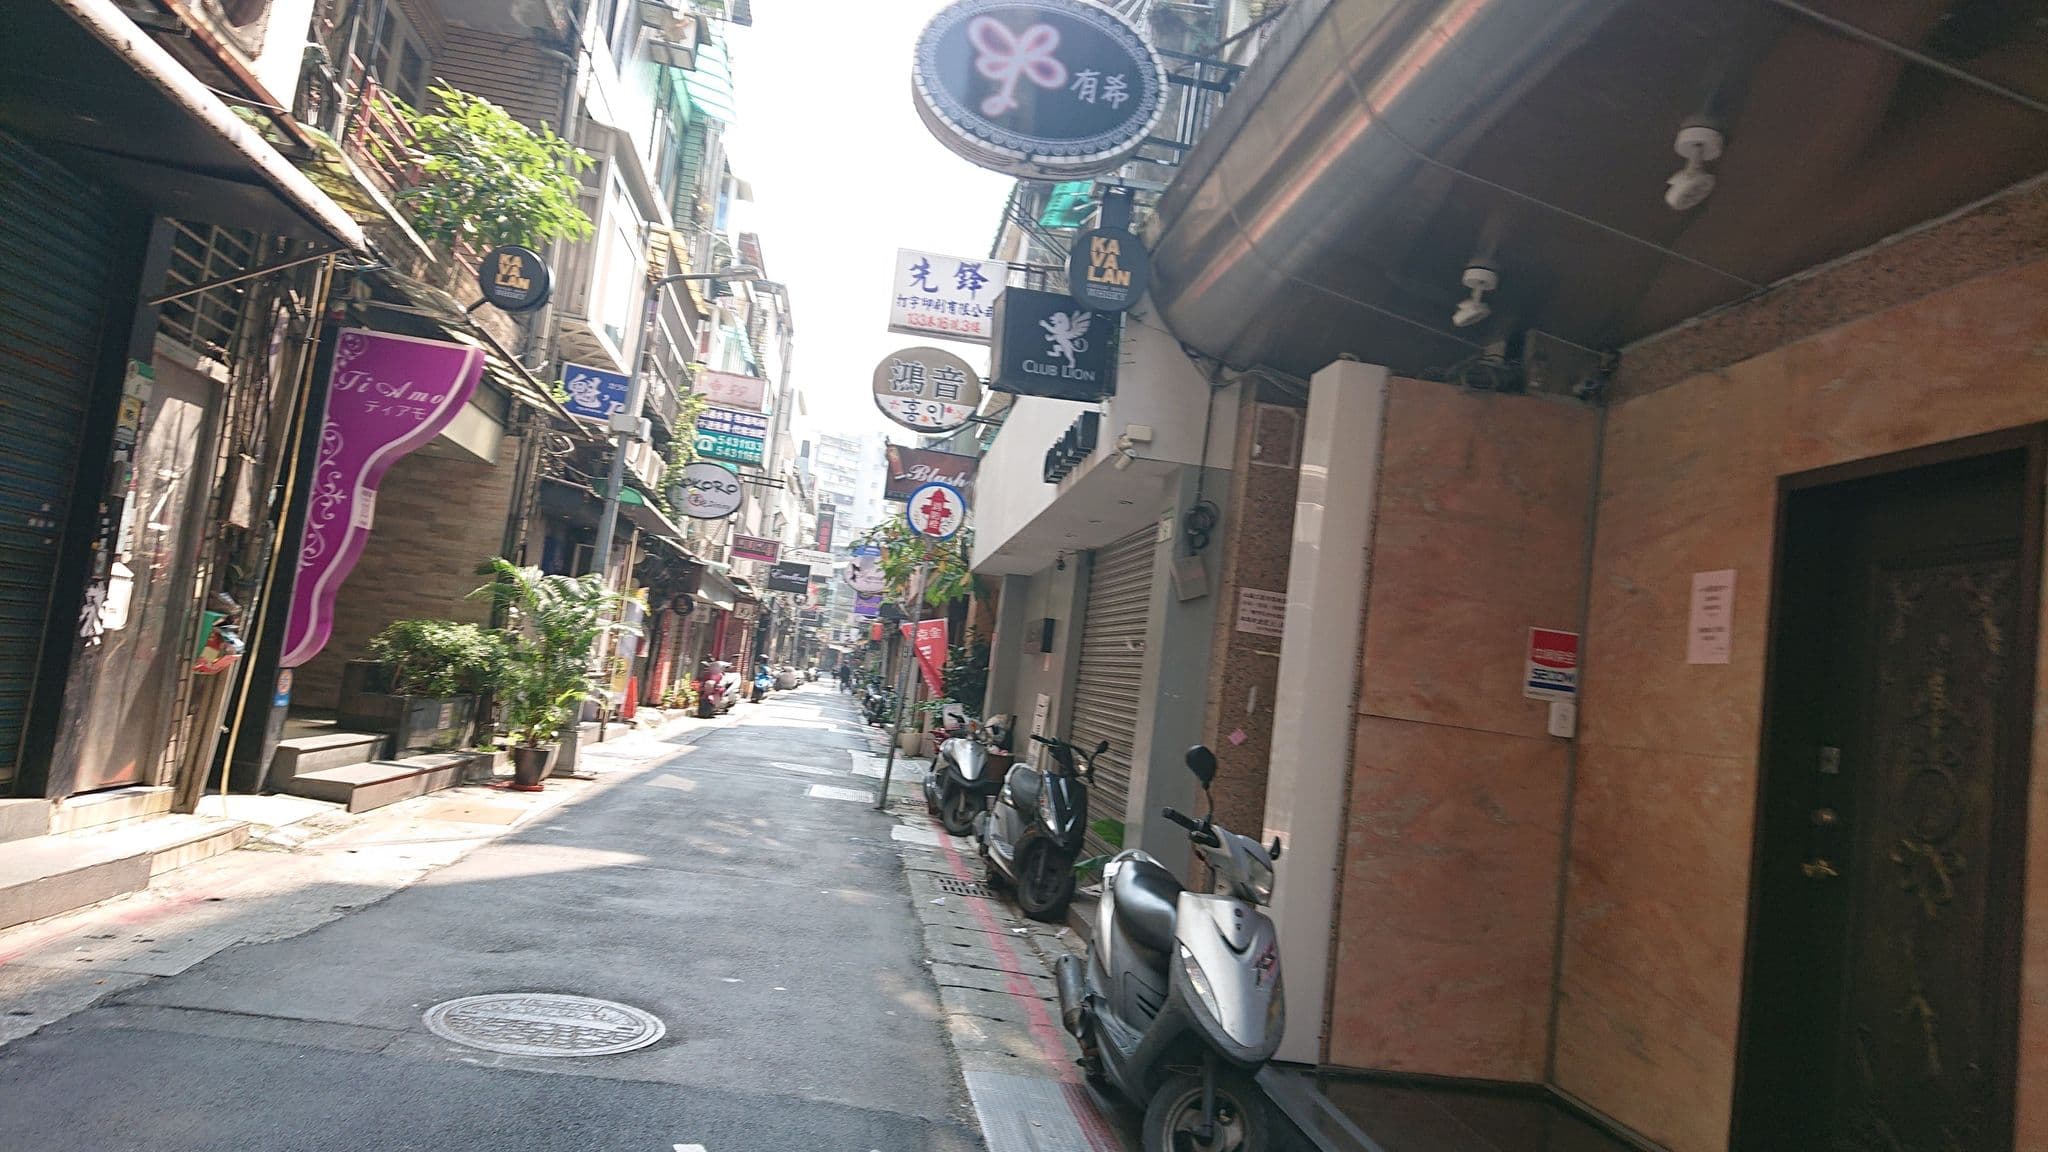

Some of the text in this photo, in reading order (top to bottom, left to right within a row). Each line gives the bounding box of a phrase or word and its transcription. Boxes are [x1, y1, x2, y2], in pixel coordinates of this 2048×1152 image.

[1070, 68, 1129, 109] 有希
[1091, 236, 1120, 254] KA
[1091, 250, 1119, 269] VA
[495, 273, 530, 290] LAN
[1087, 265, 1131, 286] LAN
[334, 370, 445, 404] Ti Amo
[888, 358, 967, 402] 鴻音
[902, 399, 945, 426] 홍인
[908, 464, 968, 488] Blush
